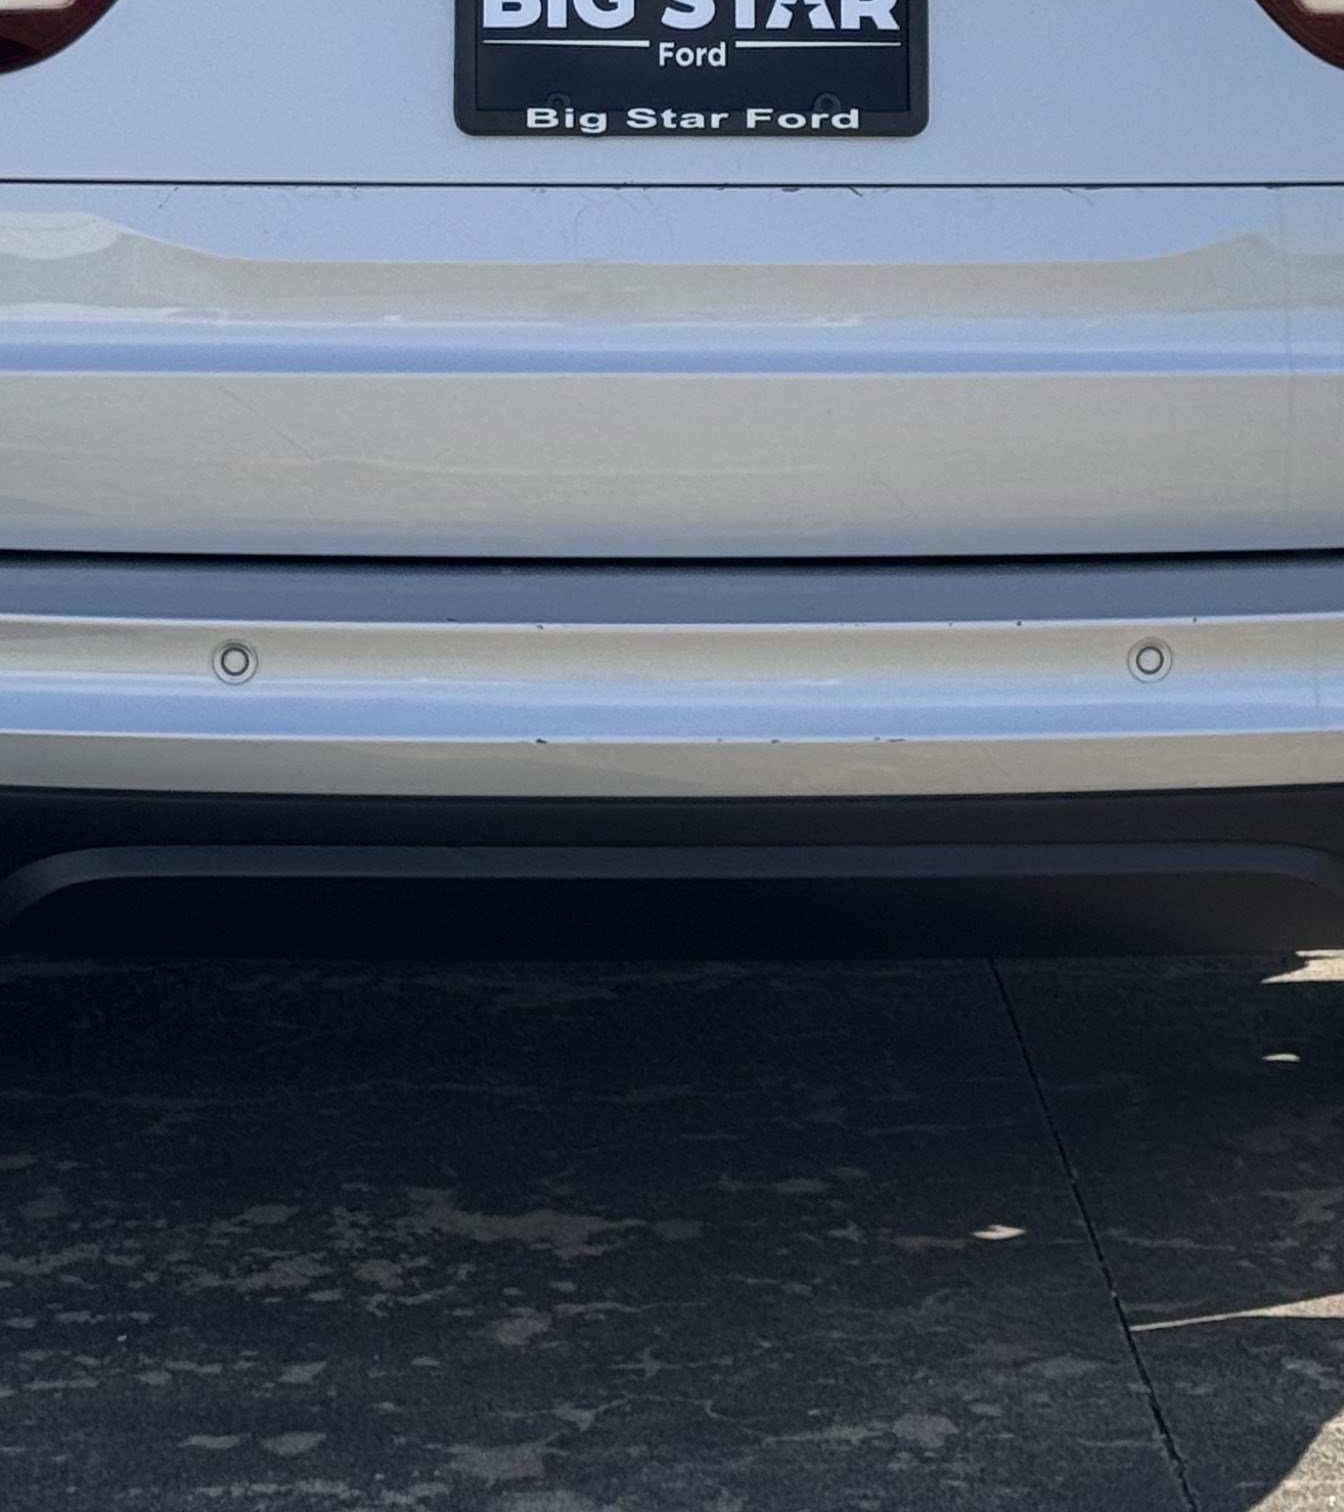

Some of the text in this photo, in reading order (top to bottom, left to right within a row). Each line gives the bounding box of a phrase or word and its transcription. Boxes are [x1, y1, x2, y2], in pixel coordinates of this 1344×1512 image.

[658, 41, 727, 68] Ford
[525, 107, 861, 134] Big Star Ford
